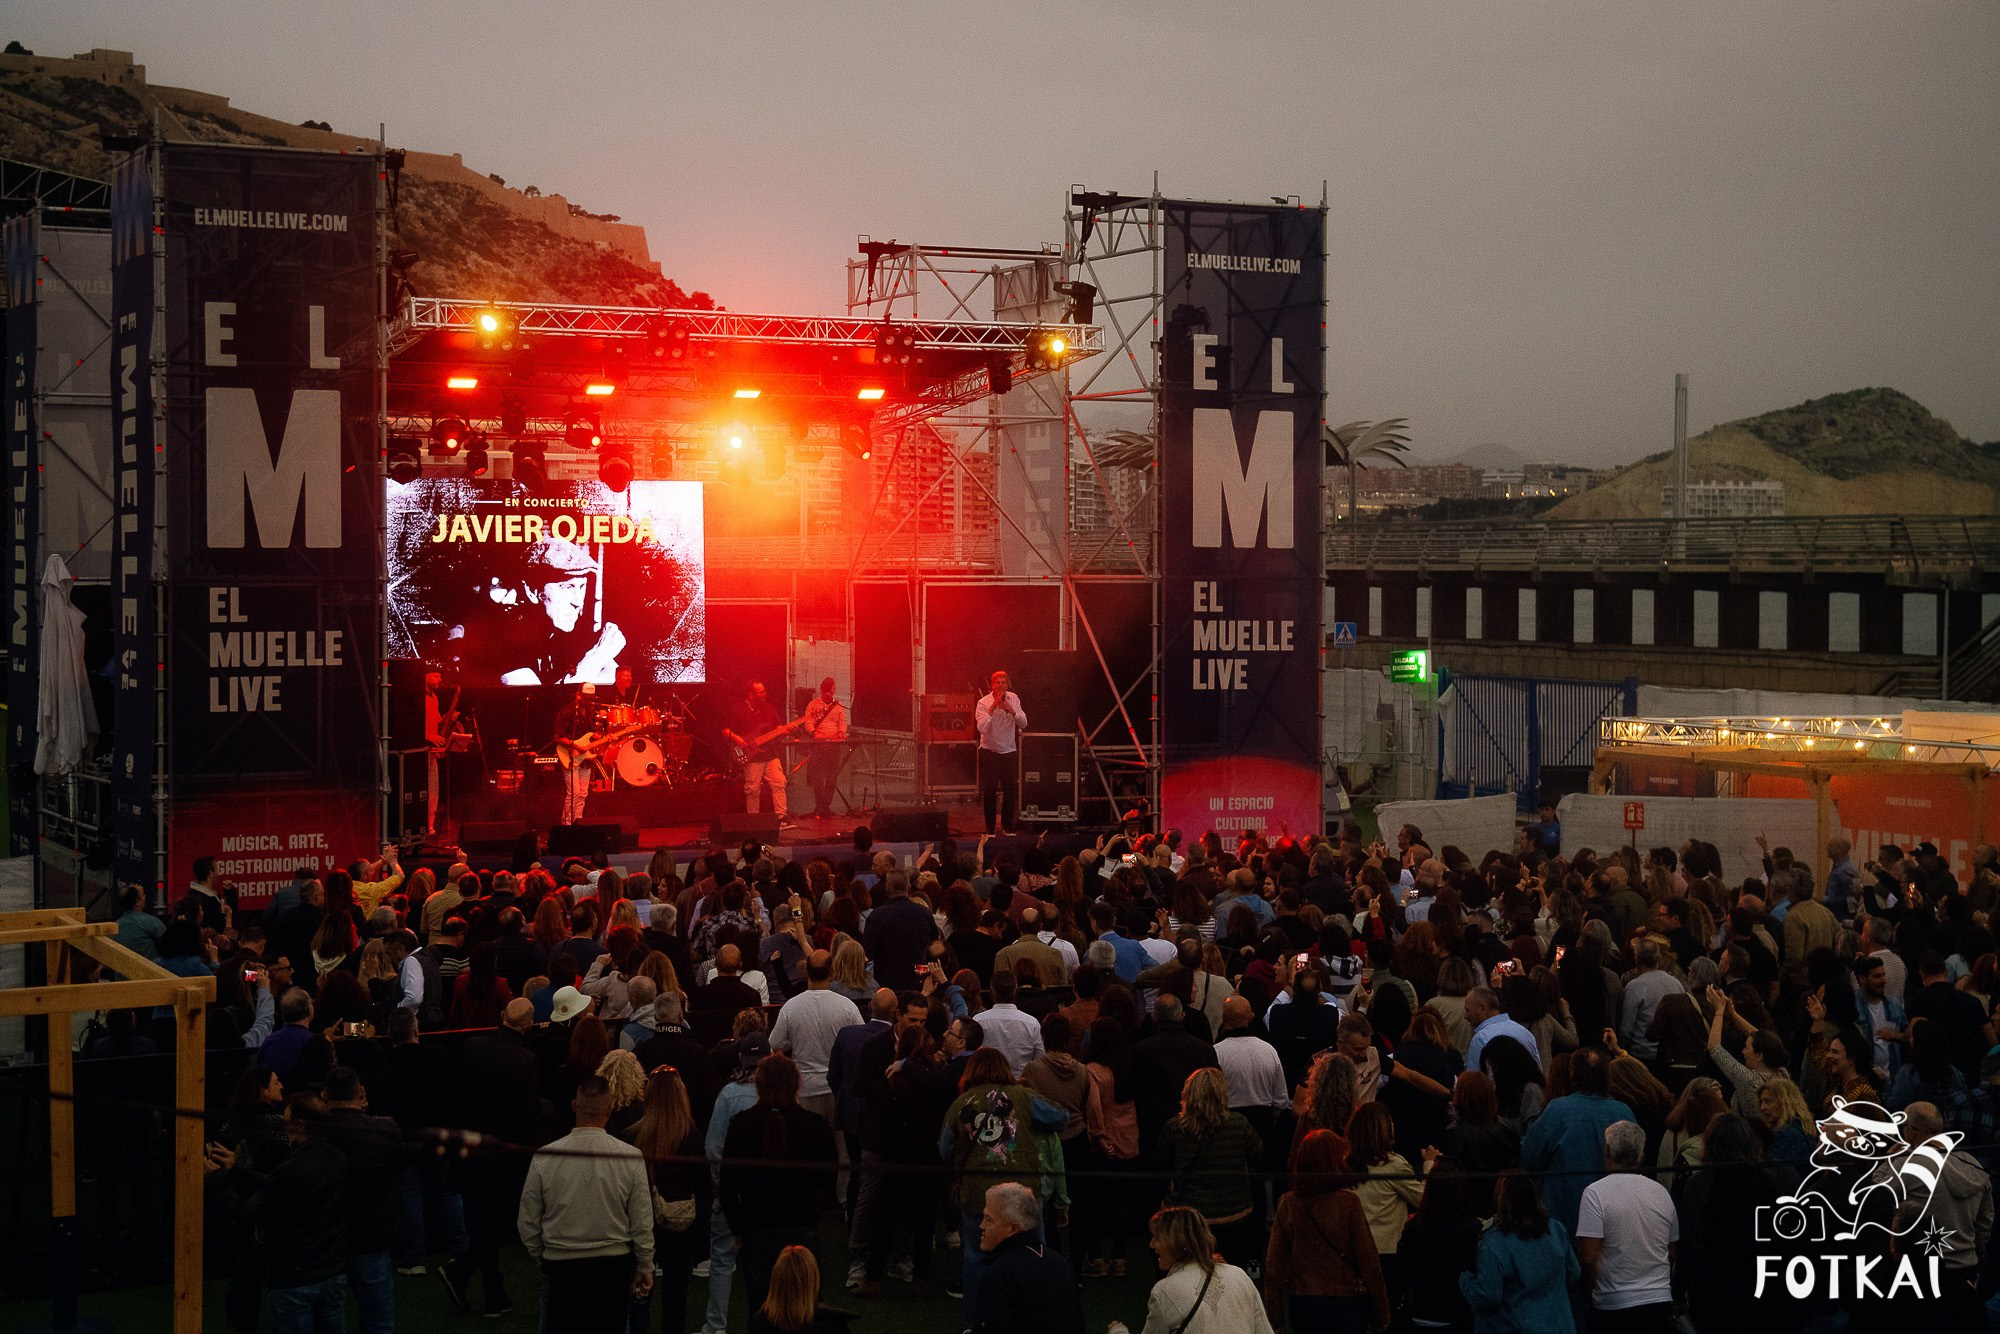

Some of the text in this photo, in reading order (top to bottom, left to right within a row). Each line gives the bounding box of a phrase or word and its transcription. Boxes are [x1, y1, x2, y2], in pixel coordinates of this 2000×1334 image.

[194, 208, 348, 232] ELMUELLELIVE.COM
[1187, 252, 1301, 275] ELMUELLELIVE.COM
[206, 387, 342, 549] M
[1192, 408, 1294, 549] M
[504, 497, 590, 508] EN CONCIERTO
[432, 514, 658, 544] JAVIER OJEDA
[209, 587, 248, 623] EL
[1193, 581, 1223, 612] EL
[209, 630, 343, 668] MUELLE
[1193, 620, 1294, 651] MUELLE
[1193, 658, 1248, 689] LIVE
[209, 675, 282, 713] LIVE
[1210, 796, 1274, 811] UN ESPACIO
[1215, 816, 1268, 831] CULTURAL
[288, 832, 329, 850] ARTE,
[325, 855, 335, 871] Y
